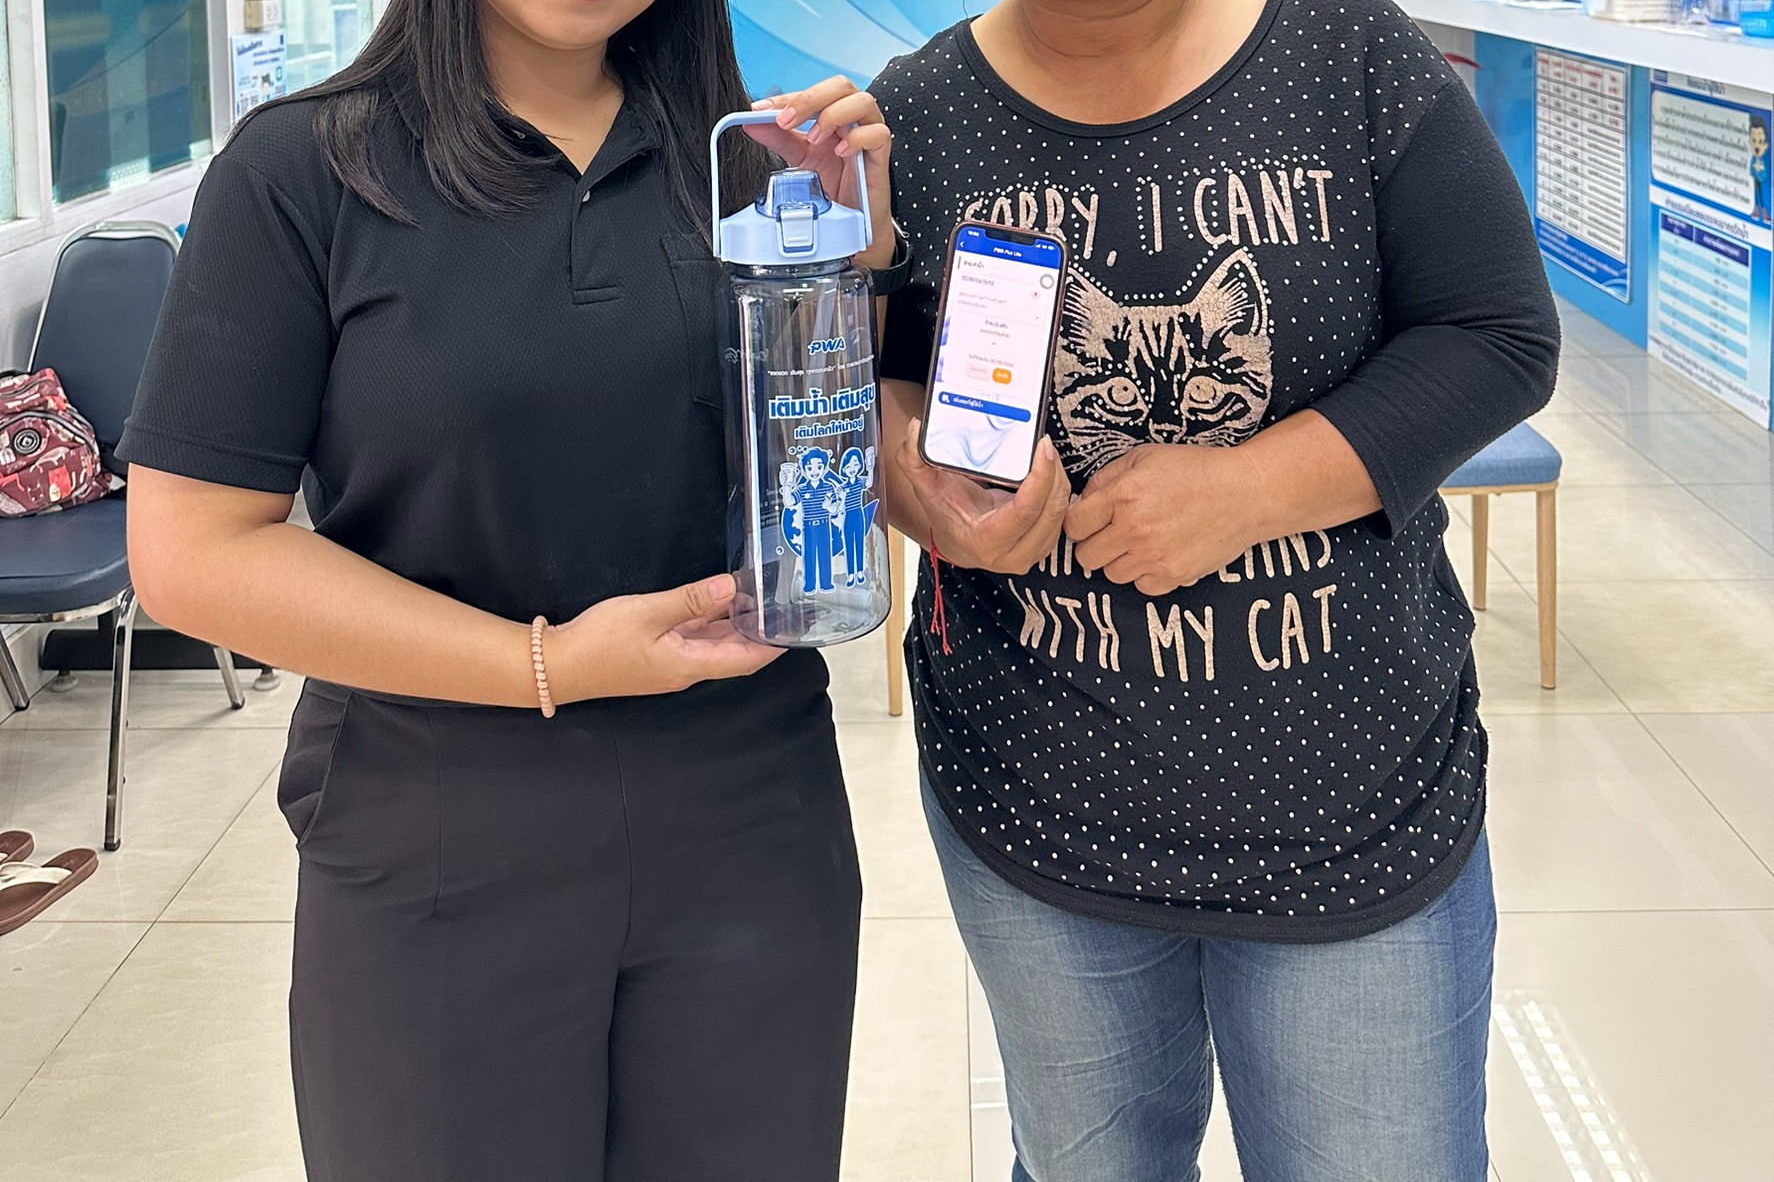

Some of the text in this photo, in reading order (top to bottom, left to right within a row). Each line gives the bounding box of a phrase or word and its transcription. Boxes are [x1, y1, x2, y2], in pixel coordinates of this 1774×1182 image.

[1150, 184, 1162, 253] I
[1196, 168, 1333, 247] CAN'T
[807, 337, 846, 355] PWA
[769, 382, 876, 419] เติมน้ำ เติมสุข
[794, 414, 865, 440] เติมโลกให้น่าอยู่
[1007, 578, 1338, 682] WITH MY CAT
